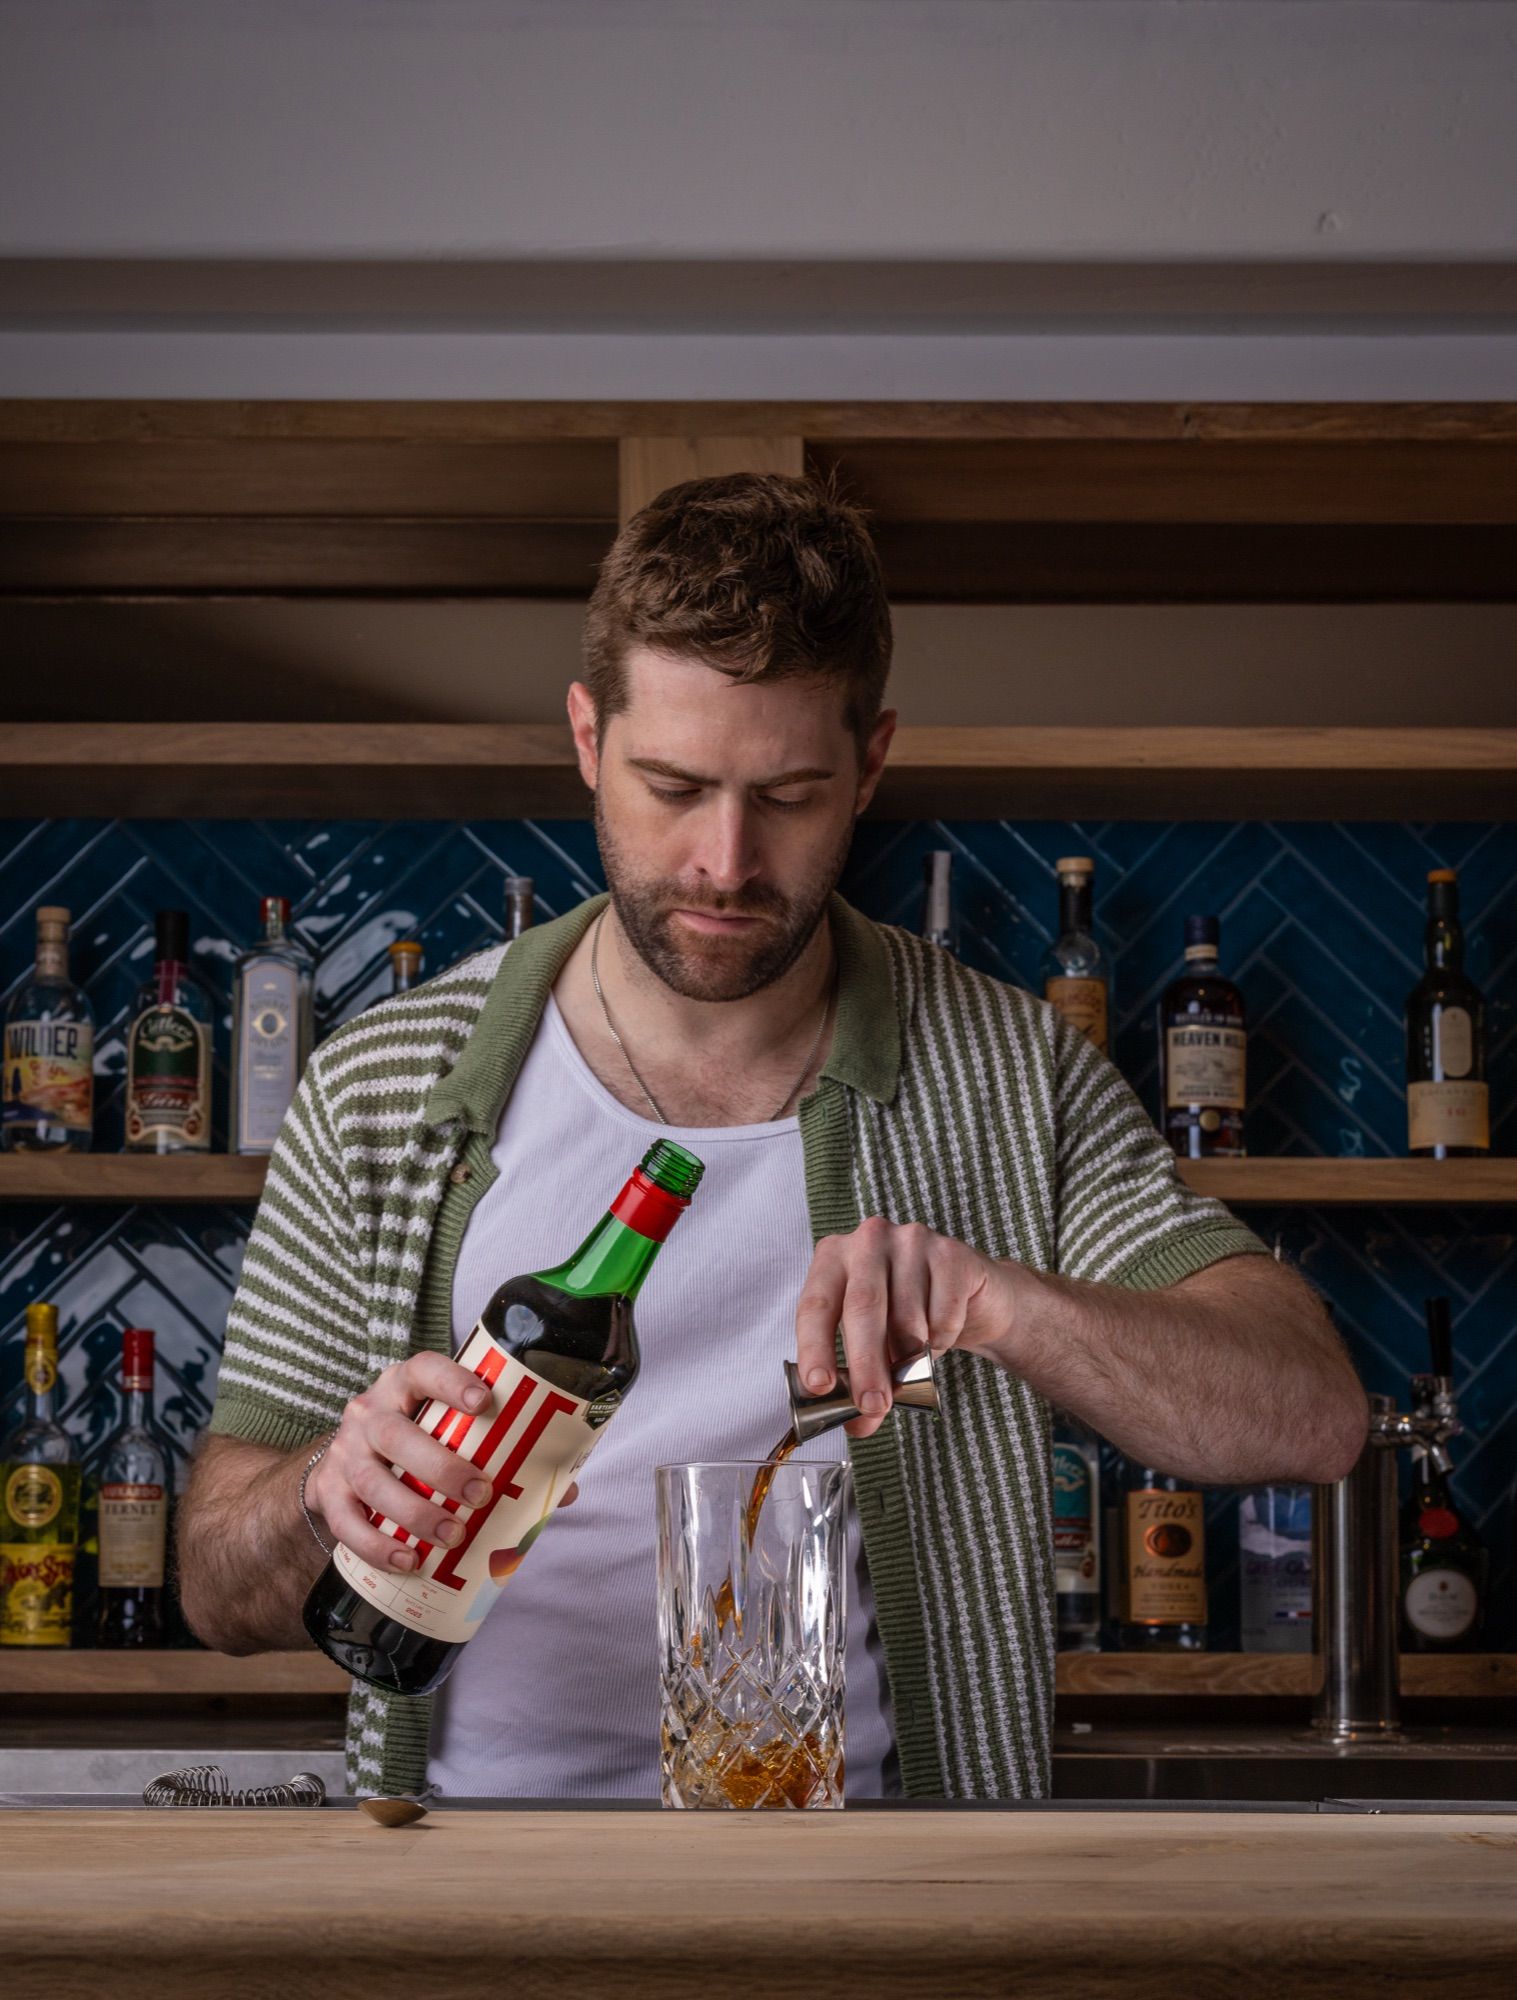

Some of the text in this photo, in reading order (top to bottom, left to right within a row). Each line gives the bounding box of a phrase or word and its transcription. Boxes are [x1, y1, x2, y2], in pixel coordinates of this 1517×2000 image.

[1173, 1031, 1220, 1047] HEAVEN
[104, 1503, 160, 1516] FERNET
[1138, 1497, 1197, 1520] Tito's
